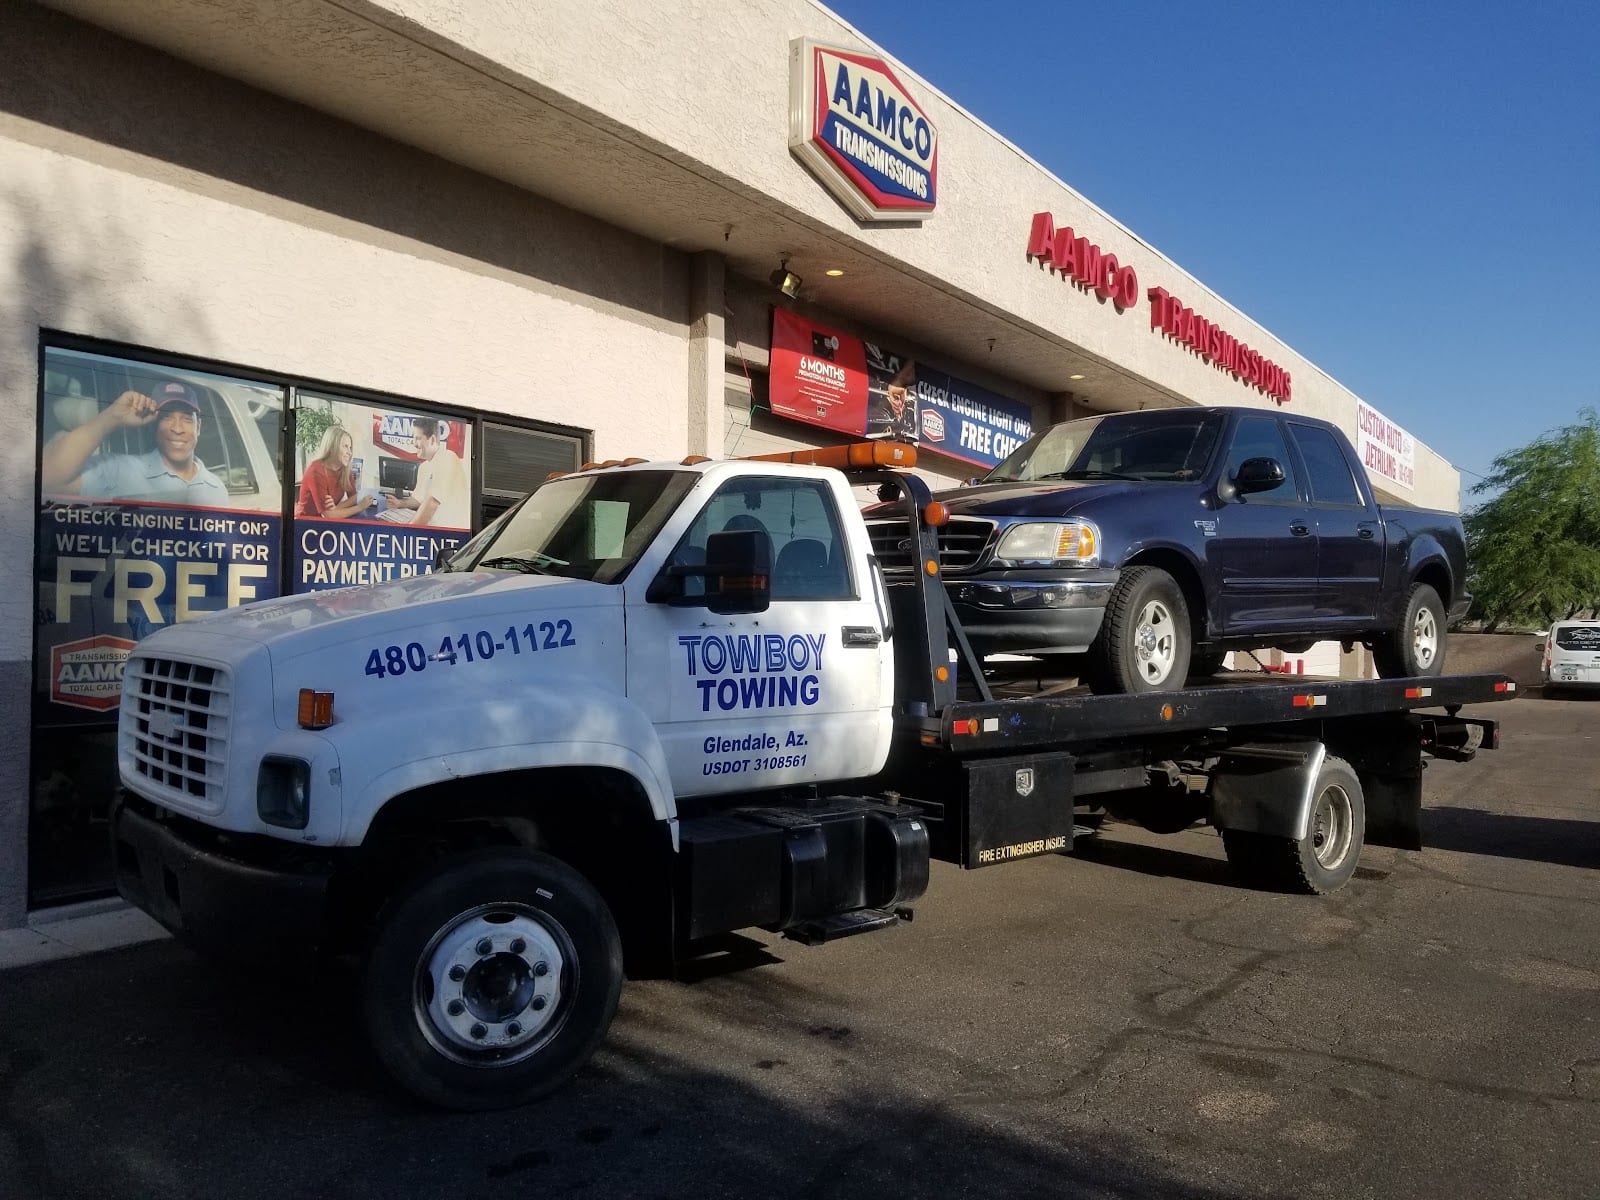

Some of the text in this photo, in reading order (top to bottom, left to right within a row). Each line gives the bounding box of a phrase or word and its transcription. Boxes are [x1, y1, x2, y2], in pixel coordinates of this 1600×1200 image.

[832, 62, 931, 161] AAMCO
[834, 121, 928, 199] TRANSMISSIONS
[1027, 211, 1291, 401] AAMCO TRANSMISSIONS
[800, 356, 845, 382] 6 MONTHS
[917, 381, 950, 409] CHECK
[951, 393, 987, 423] ENGINE
[988, 408, 1014, 432] LIGHT
[1014, 417, 1031, 439] ON?
[379, 415, 451, 441] AAMO
[960, 420, 991, 455] FREE
[1359, 404, 1403, 454] CUSTOM AUTO
[1365, 441, 1397, 480] DETAILING
[54, 508, 270, 536] CHECK ENGINE LIGHT ON?
[56, 533, 269, 561] WE'LL CHECK IT FOR
[301, 529, 459, 561] CONVENIENT
[302, 559, 436, 585] PAYMENT PLA
[364, 619, 576, 679] 480-410-1122
[678, 634, 826, 676] TOWBOY
[70, 684, 94, 692] TOTAL
[96, 683, 113, 691] CAR
[696, 675, 819, 712] TOWING
[703, 730, 808, 754] Glendale, Az.
[702, 754, 807, 776] USDOT 3108561
[979, 836, 1066, 863] FIRE EXTINGUISHER INSIDE
